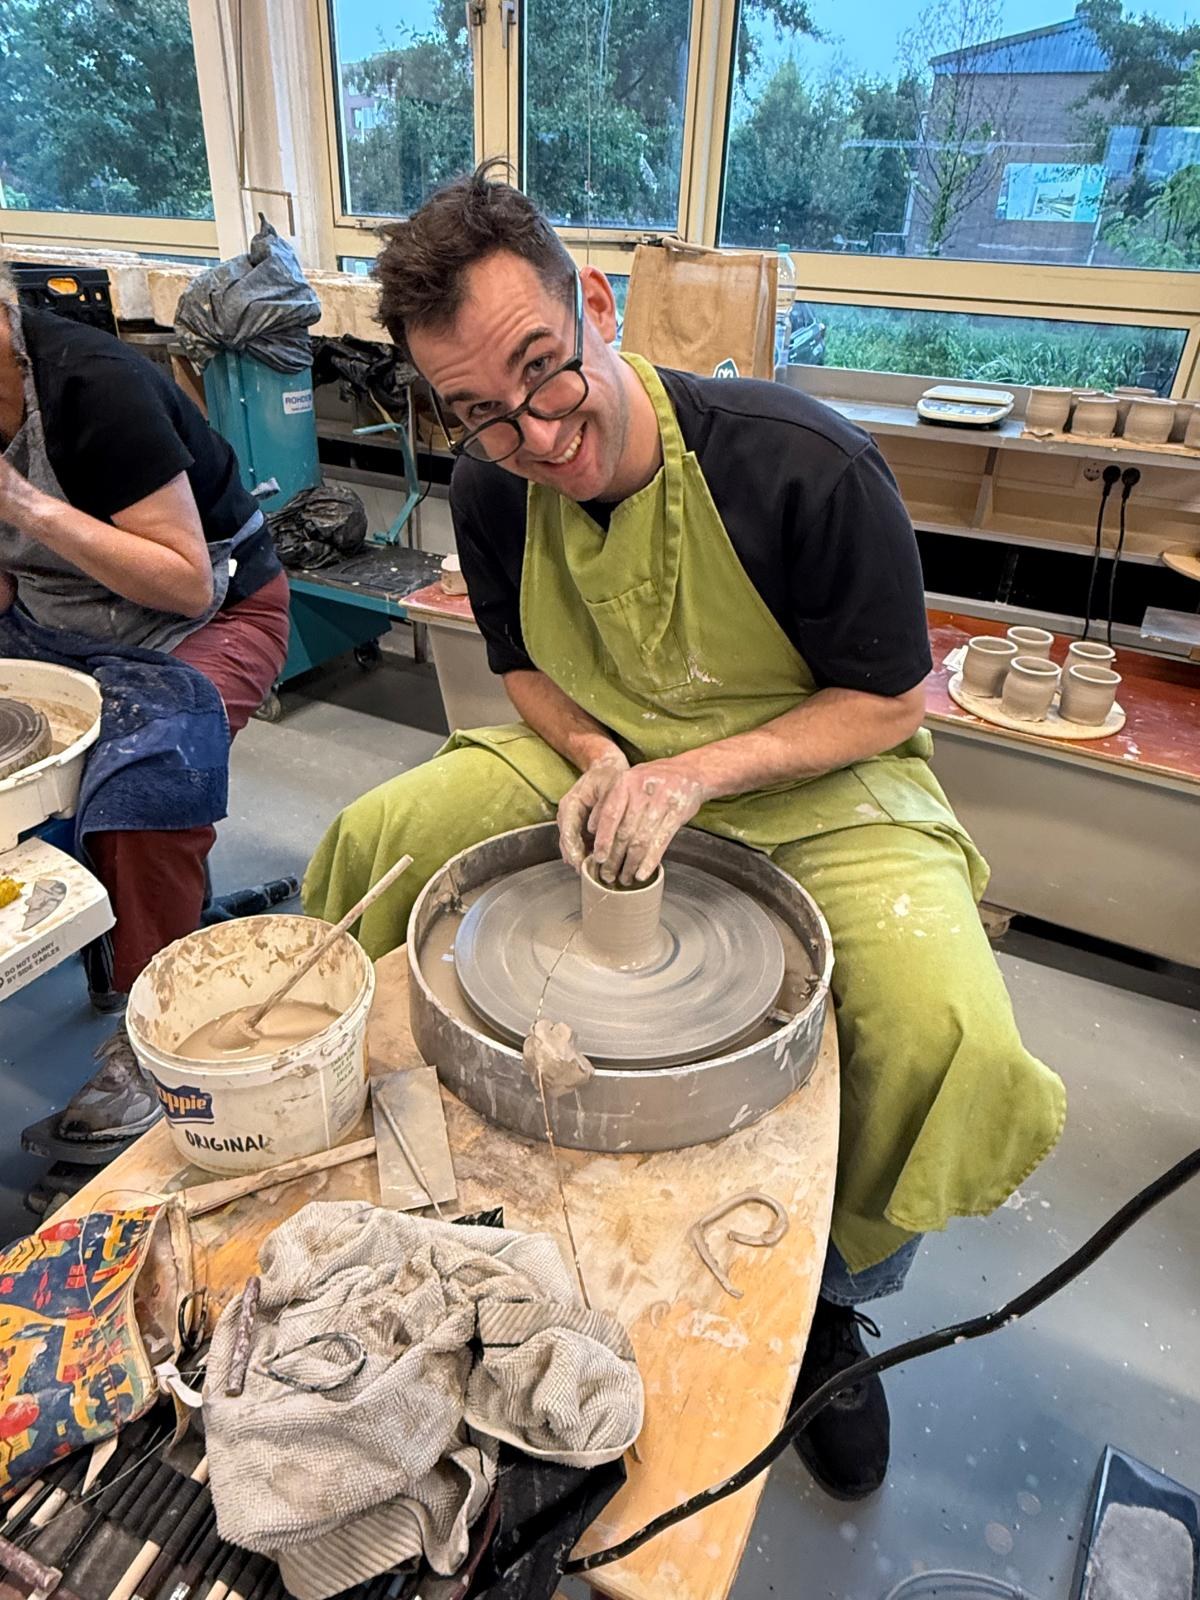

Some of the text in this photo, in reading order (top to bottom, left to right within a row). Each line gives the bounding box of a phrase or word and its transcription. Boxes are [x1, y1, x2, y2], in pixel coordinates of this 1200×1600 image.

[4, 940, 54, 978] DO NOT CARRY
[6, 945, 60, 985] BY SIDE TABLES
